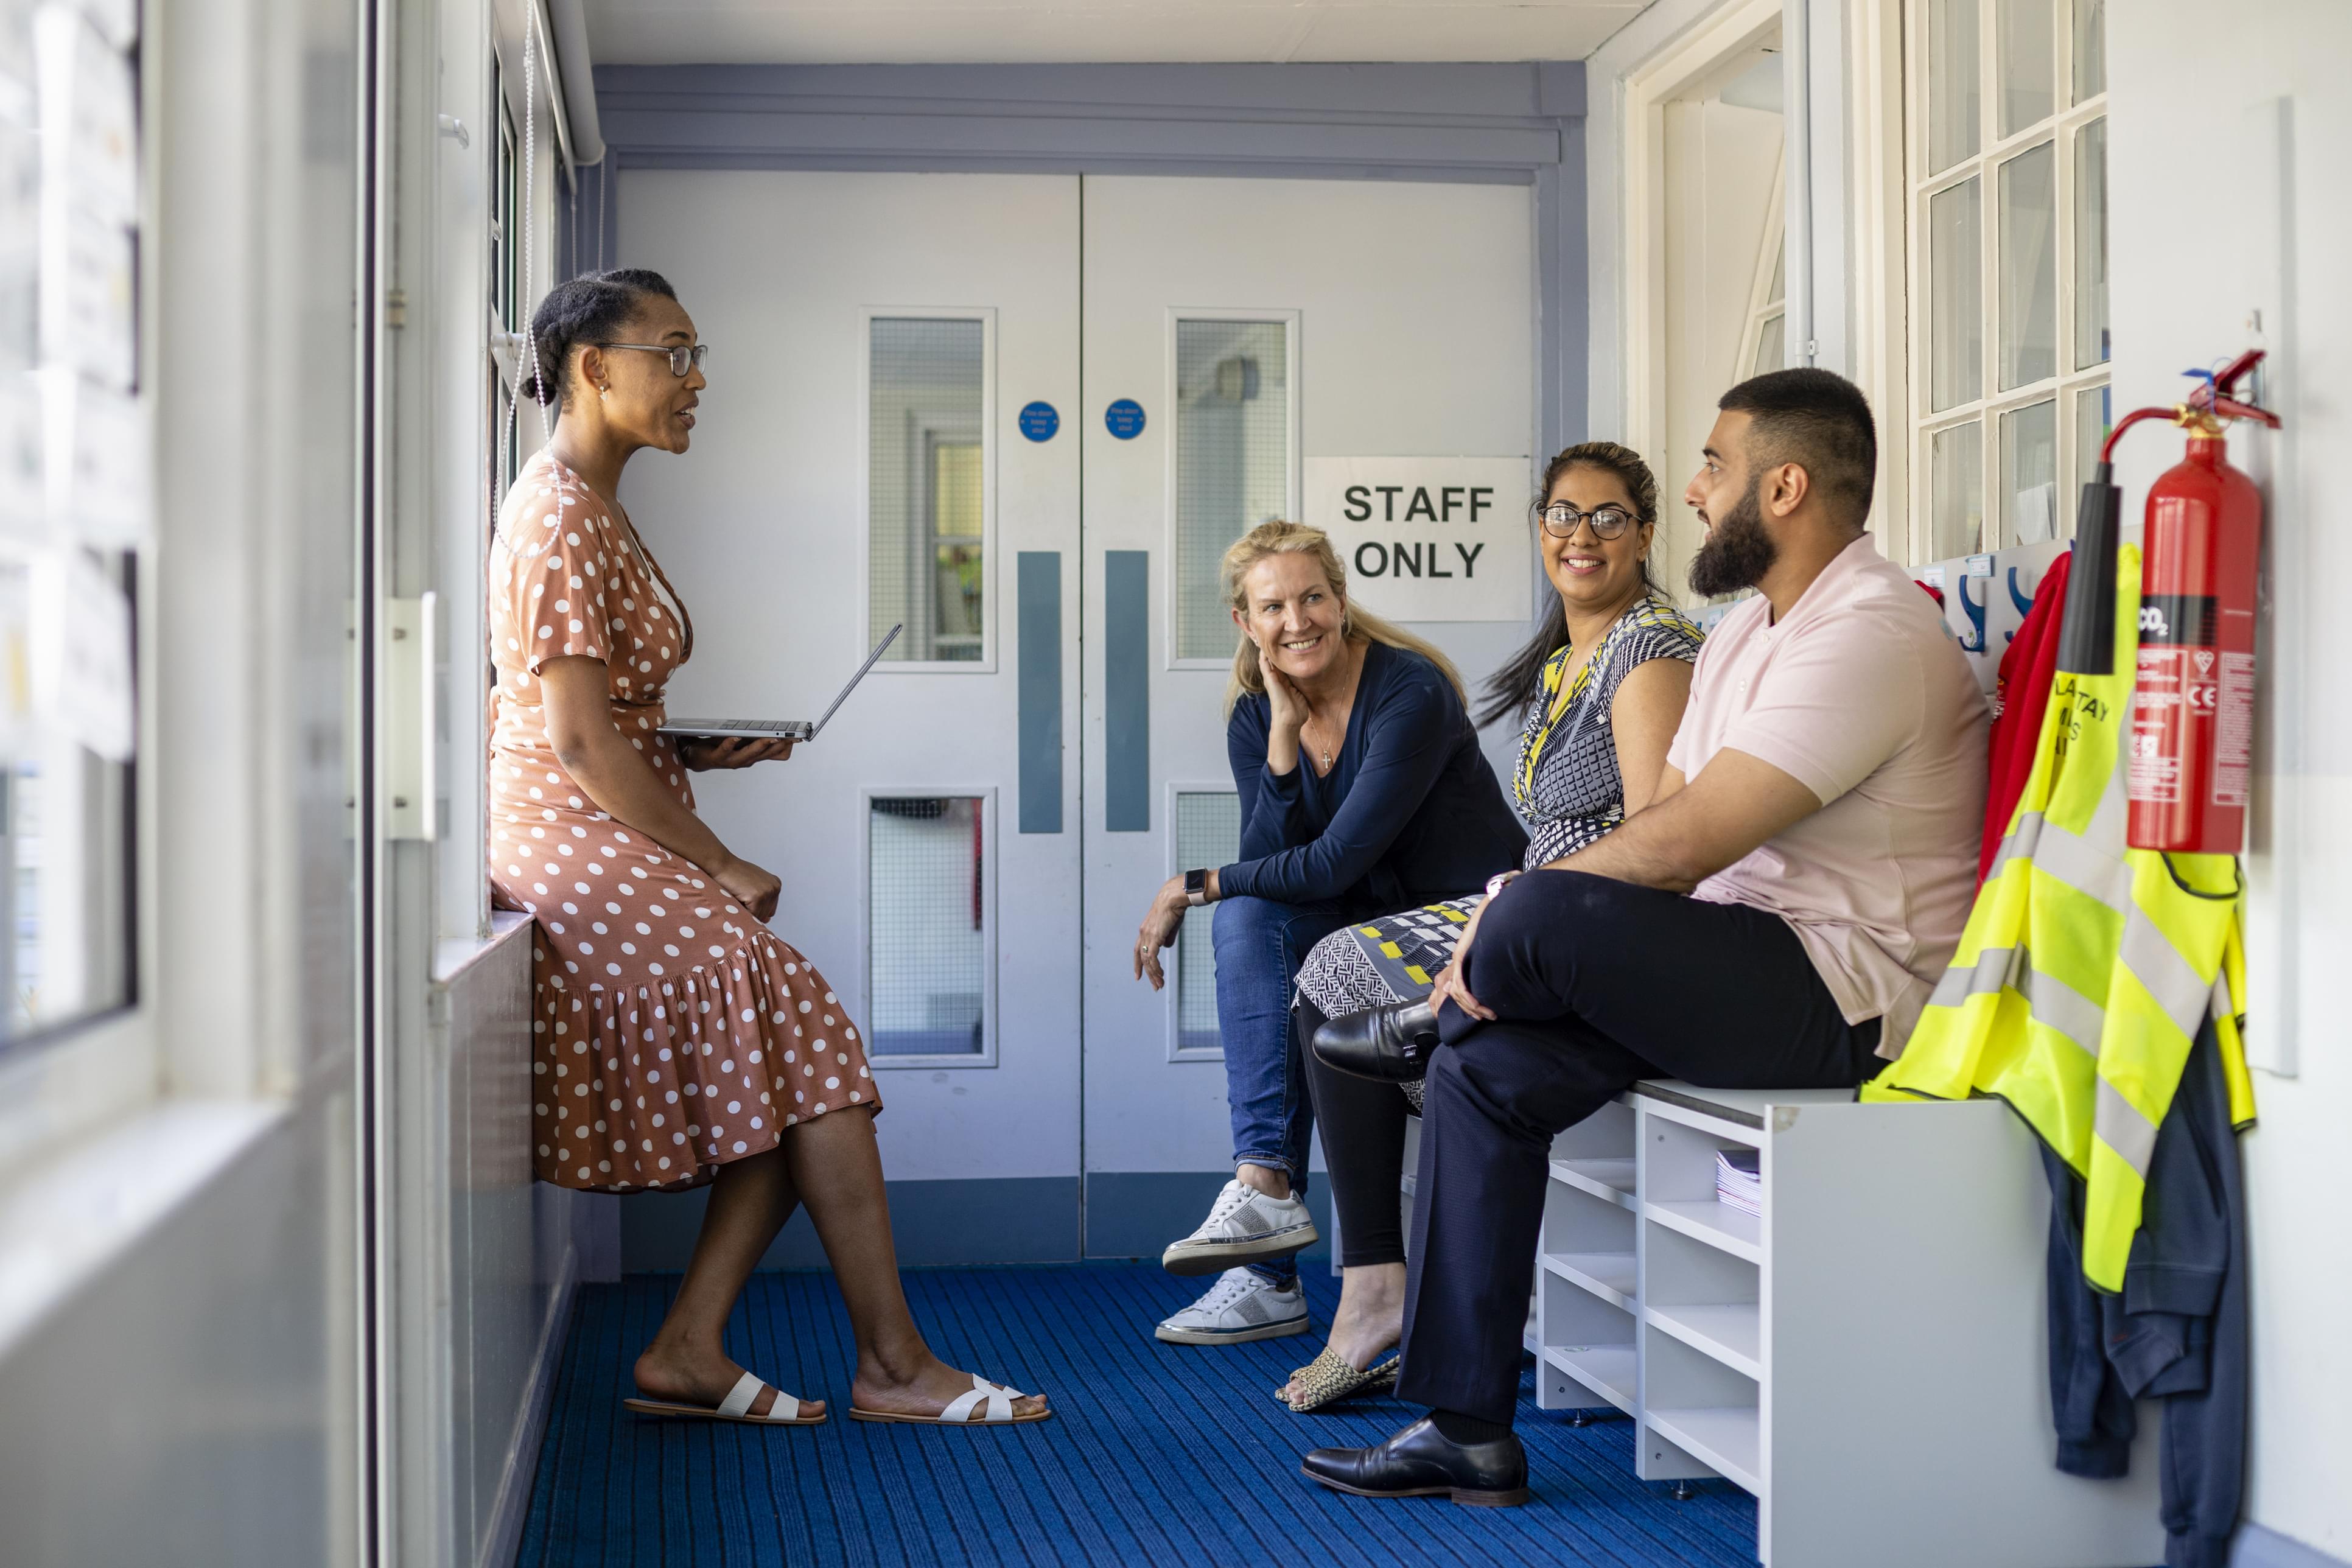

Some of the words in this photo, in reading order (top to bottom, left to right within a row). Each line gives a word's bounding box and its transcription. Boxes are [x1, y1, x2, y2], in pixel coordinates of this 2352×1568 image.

[1344, 486, 1494, 522] STAFF
[1355, 542, 1485, 578] ONLY
[2188, 686, 2216, 707] CE
